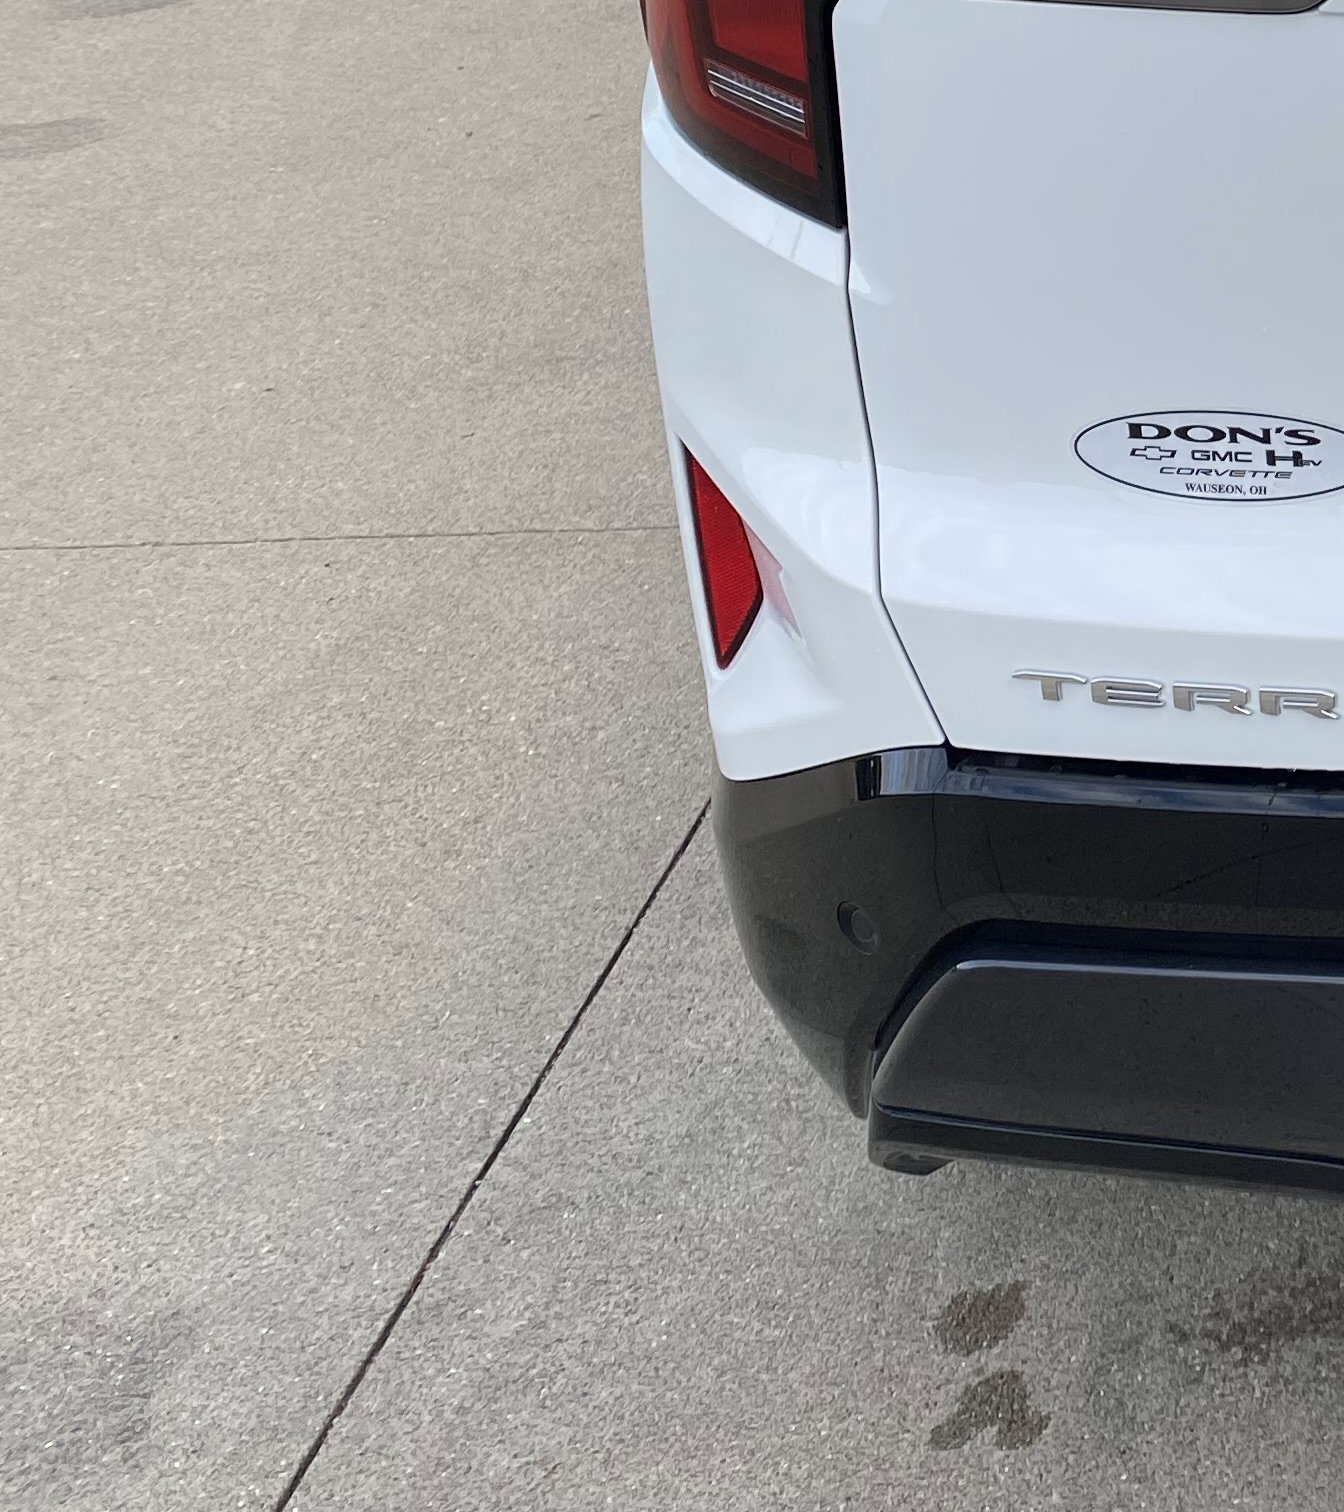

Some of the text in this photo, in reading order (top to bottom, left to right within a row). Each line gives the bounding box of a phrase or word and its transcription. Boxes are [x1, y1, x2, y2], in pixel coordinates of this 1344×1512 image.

[1126, 422, 1321, 446] DON'S
[1191, 450, 1252, 463] GMC
[1159, 466, 1293, 479] CORVETTE
[1185, 483, 1267, 496] WAUSEON, OH
